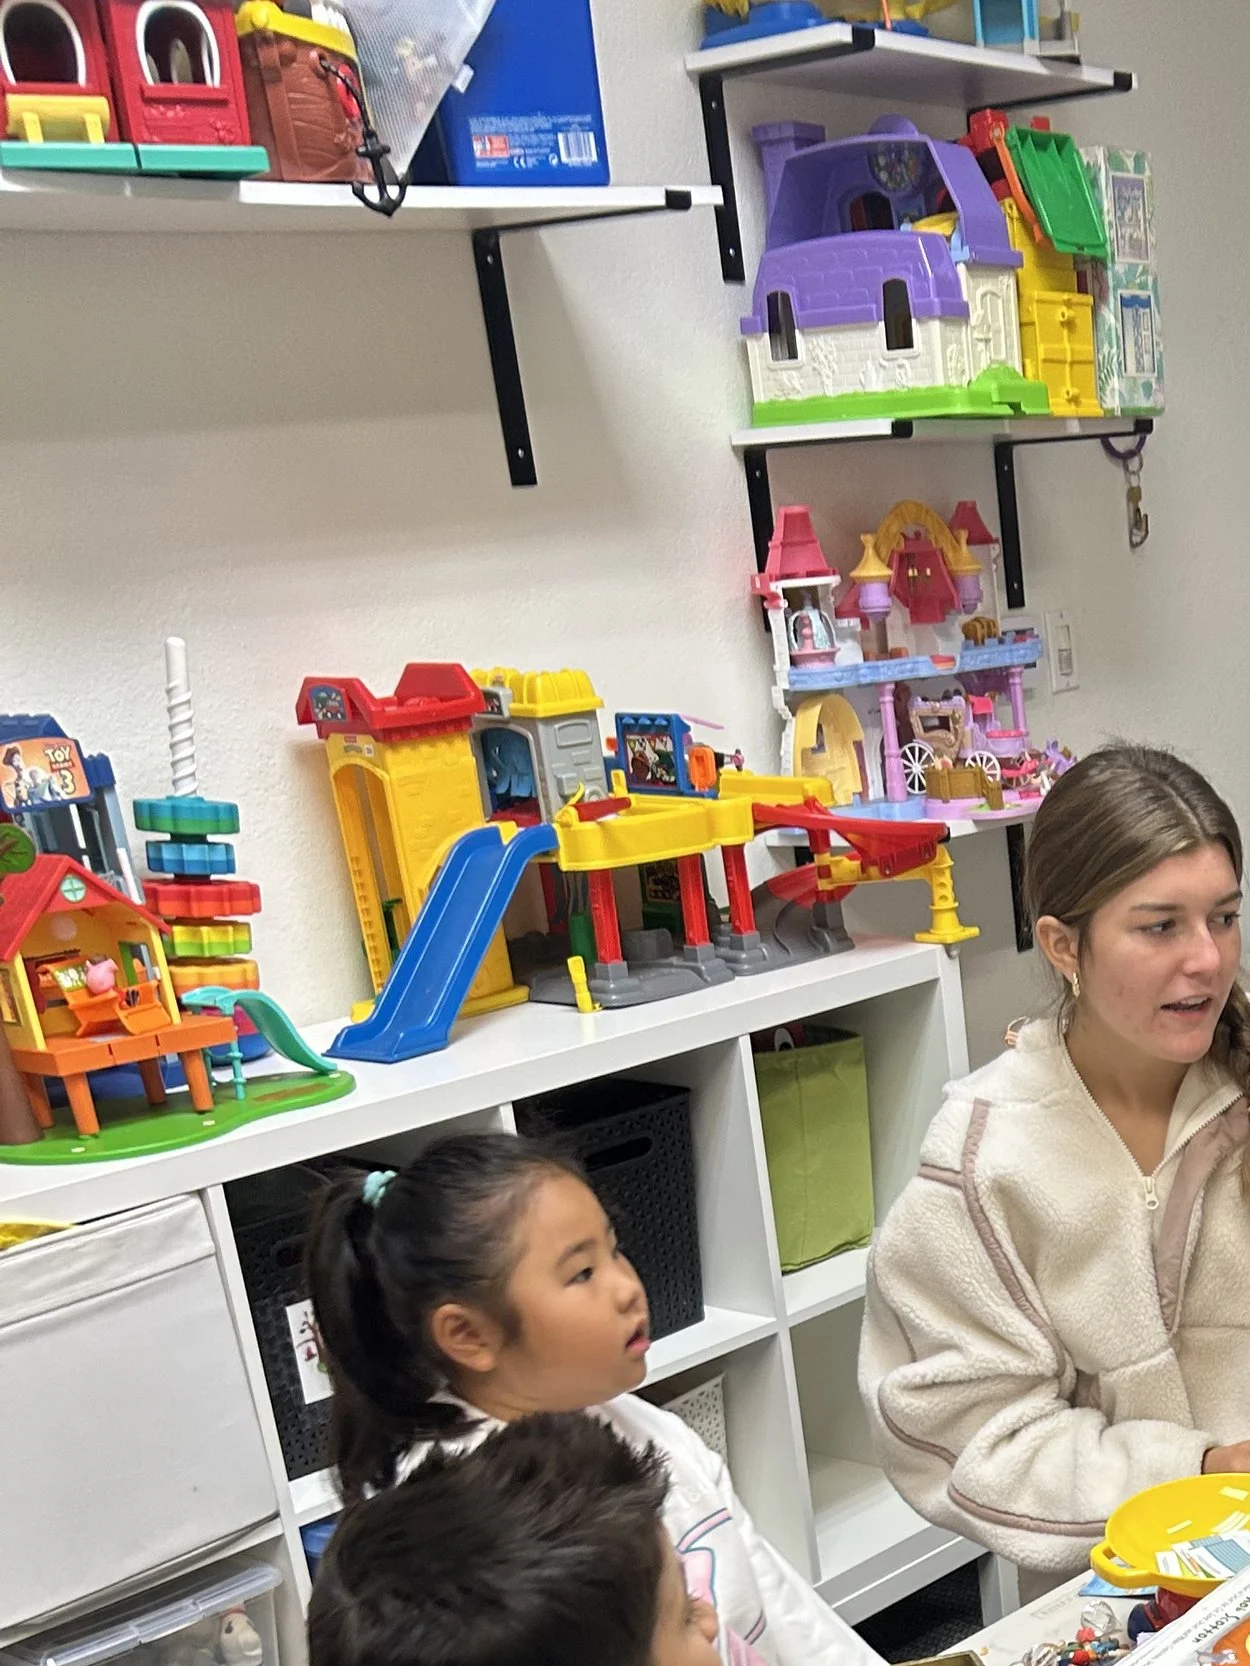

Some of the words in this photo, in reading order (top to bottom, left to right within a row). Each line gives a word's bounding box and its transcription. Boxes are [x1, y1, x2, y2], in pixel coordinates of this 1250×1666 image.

[44, 745, 72, 763] TOY
[60, 767, 77, 795] 3
[1191, 1612, 1240, 1643] Scotton
